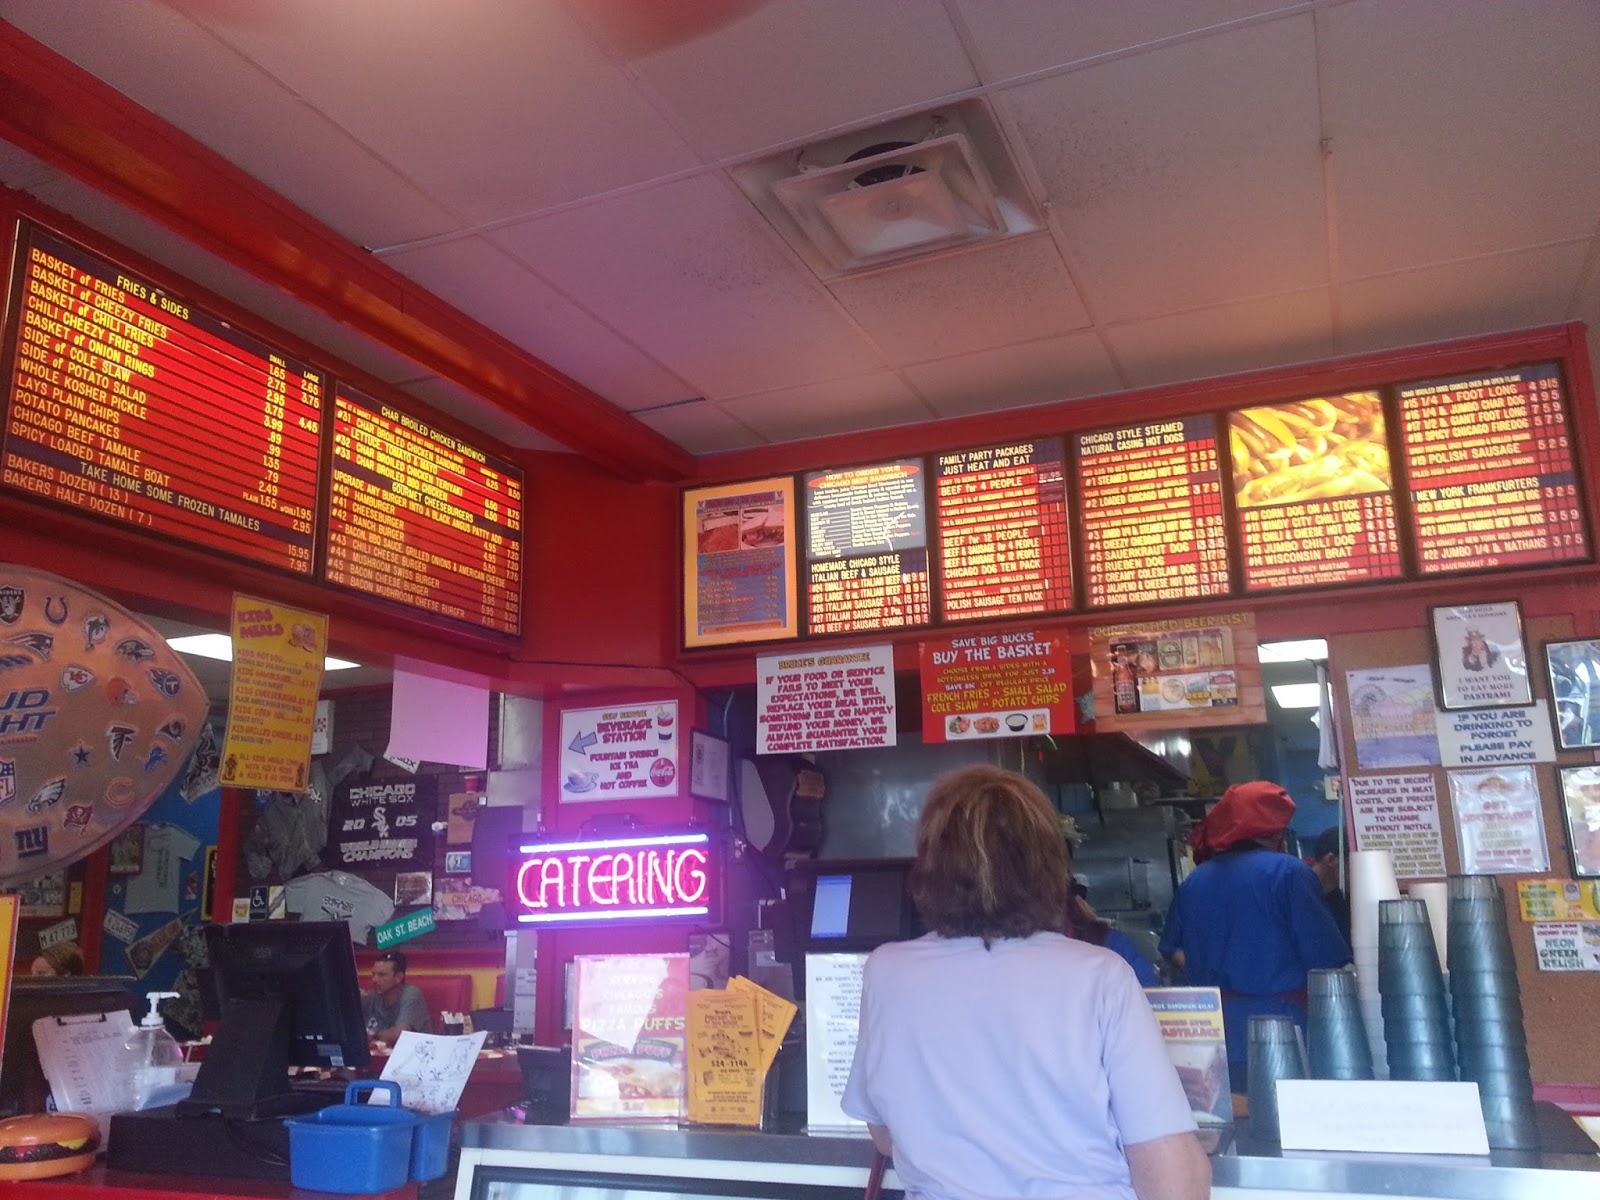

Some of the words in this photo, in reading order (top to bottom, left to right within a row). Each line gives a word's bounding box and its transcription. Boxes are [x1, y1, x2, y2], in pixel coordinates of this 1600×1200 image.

[32, 249, 76, 279] BASKET
[80, 275, 90, 285] of
[94, 279, 125, 304] FRIES
[32, 267, 76, 296] BASKET
[80, 291, 90, 300] of
[94, 296, 134, 321] CHEEZY
[138, 314, 167, 338] FRIES
[117, 276, 147, 297] FRIES
[150, 292, 156, 303] &
[160, 295, 188, 320] SIDES
[30, 281, 74, 311] BASKET
[78, 305, 89, 317] of
[93, 310, 120, 332] CHILI
[125, 324, 154, 348] FRIES
[29, 297, 57, 318] CHILI
[62, 310, 103, 340] CHEEZY
[109, 332, 138, 355] FRIES
[24, 327, 48, 349] SIDE
[55, 342, 66, 353] of
[70, 347, 96, 370] COLE
[102, 360, 131, 382] SLAW
[26, 312, 69, 341] BASKET
[74, 335, 84, 345] of
[88, 339, 120, 365] ONION
[124, 354, 154, 377] RINGS
[22, 343, 46, 364] SIDE
[53, 358, 64, 369] of
[68, 363, 108, 389] POTATO
[113, 382, 146, 404] SALAD
[18, 376, 48, 398] LAYS
[53, 391, 84, 413] PLAIN
[89, 405, 120, 424] CHIPS
[21, 359, 59, 386] WHOLE
[64, 376, 107, 404] KOSHER
[111, 396, 147, 420] PICKLE
[16, 391, 60, 418] POTATO
[65, 409, 120, 439] PANCAKES
[14, 407, 62, 436] CHICAGO
[67, 427, 94, 447] BEEF
[100, 438, 141, 462] TAMALE
[381, 407, 398, 422] CHAR
[401, 416, 428, 437] BROILED
[430, 429, 455, 449] CHICKEN
[457, 442, 486, 463] SANDWICH
[1080, 432, 1114, 445] CHICAGO
[1116, 427, 1142, 439] STYLE
[1144, 422, 1184, 436] STEAMED
[1081, 443, 1114, 455] NATURAL
[1117, 438, 1144, 450] CASING
[1146, 436, 1161, 446] HOT
[1164, 433, 1184, 444] DOGS
[12, 422, 44, 445] SPICY
[51, 438, 92, 461] LOADED
[98, 453, 139, 479] TAMALE
[144, 468, 170, 487] BOAT
[356, 419, 374, 434] CHAR
[377, 427, 404, 448] BROILED
[407, 442, 433, 462] CHICKEN
[435, 456, 465, 475] SANDWICH
[939, 453, 968, 466] FAMILY
[972, 450, 996, 462] PARTY
[999, 445, 1034, 460] PACKAGES
[1429, 448, 1468, 464] POLISH
[1472, 443, 1520, 459] SAUSAGE
[943, 464, 963, 475] JUST
[967, 461, 990, 473] HEAT
[993, 458, 1011, 469] AND
[1014, 455, 1031, 466] EAT
[80, 462, 107, 483] TAKE
[113, 474, 141, 494] HOME
[147, 486, 173, 504] SOME
[178, 496, 214, 517] FROZEN
[219, 508, 259, 531] TAMALES
[1417, 489, 1437, 501] NEW
[1440, 486, 1464, 498] YORK
[1467, 477, 1539, 494] FRANKFURTERS
[355, 492, 395, 515] HAMBURGER
[392, 482, 422, 505] GOURMET
[425, 497, 474, 523] CHEESEBURGERS
[353, 503, 404, 530] CHEESEBURGER
[353, 516, 376, 532] RANCH
[379, 524, 404, 541] BURGER
[1105, 545, 1166, 560] SAUERKRAUT
[1170, 542, 1189, 553] DOG
[811, 559, 846, 573] HOMEMADE
[848, 557, 874, 569] CHICAGO
[877, 555, 900, 566] STYLE
[811, 570, 836, 582] ITALIAN
[839, 568, 857, 579] BEEF
[860, 567, 866, 577] &
[869, 565, 900, 576] SAUSAGE
[945, 566, 975, 578] CHICAGO
[978, 564, 997, 576] DOG
[1000, 562, 1016, 574] TEN
[1018, 559, 1040, 572] PACK
[951, 639, 974, 648] SAVE
[977, 637, 997, 646] BIG
[1002, 632, 1034, 643] BUCKS
[933, 651, 961, 665] BUY
[965, 648, 990, 661] THE
[998, 643, 1051, 658] BASKET
[766, 676, 773, 684] IF
[777, 674, 801, 684] YOUR
[805, 672, 828, 682] FOOD
[832, 670, 843, 678] OR
[847, 666, 885, 677] SERVICE
[927, 692, 960, 702] FRENCH
[963, 690, 989, 700] FRIES
[1004, 686, 1031, 696] SMALL
[1036, 683, 1066, 693] SALAD
[1464, 692, 1511, 700] PASTRAMI
[931, 702, 952, 712] COLE
[955, 700, 978, 710] SLAW
[992, 697, 1028, 708] POTATO
[1031, 694, 1059, 705] CHIPS
[597, 719, 652, 733] BEVERAGE
[1454, 721, 1512, 731] DRINKING
[1516, 719, 1532, 727] TO
[1458, 714, 1469, 722] IF
[1473, 713, 1498, 721] YOU
[603, 730, 646, 743] STATION
[1471, 730, 1518, 740] FORGET
[1460, 743, 1504, 752] PLEASE
[1508, 741, 1533, 749] PAY
[1477, 752, 1536, 762] ADVANCE
[350, 784, 415, 799] CHICAGO
[352, 796, 386, 806] WHITE
[389, 795, 413, 803] SOX
[518, 850, 706, 907] CATERING
[452, 894, 482, 903] CHICAGO
[377, 930, 392, 943] OAK
[396, 924, 405, 937] ST.
[408, 914, 432, 932] BEACH
[1540, 949, 1578, 958] GREEN
[1546, 938, 1575, 948] NEON
[1543, 959, 1584, 969] RELISH
[634, 1017, 685, 1031] PUFFS
